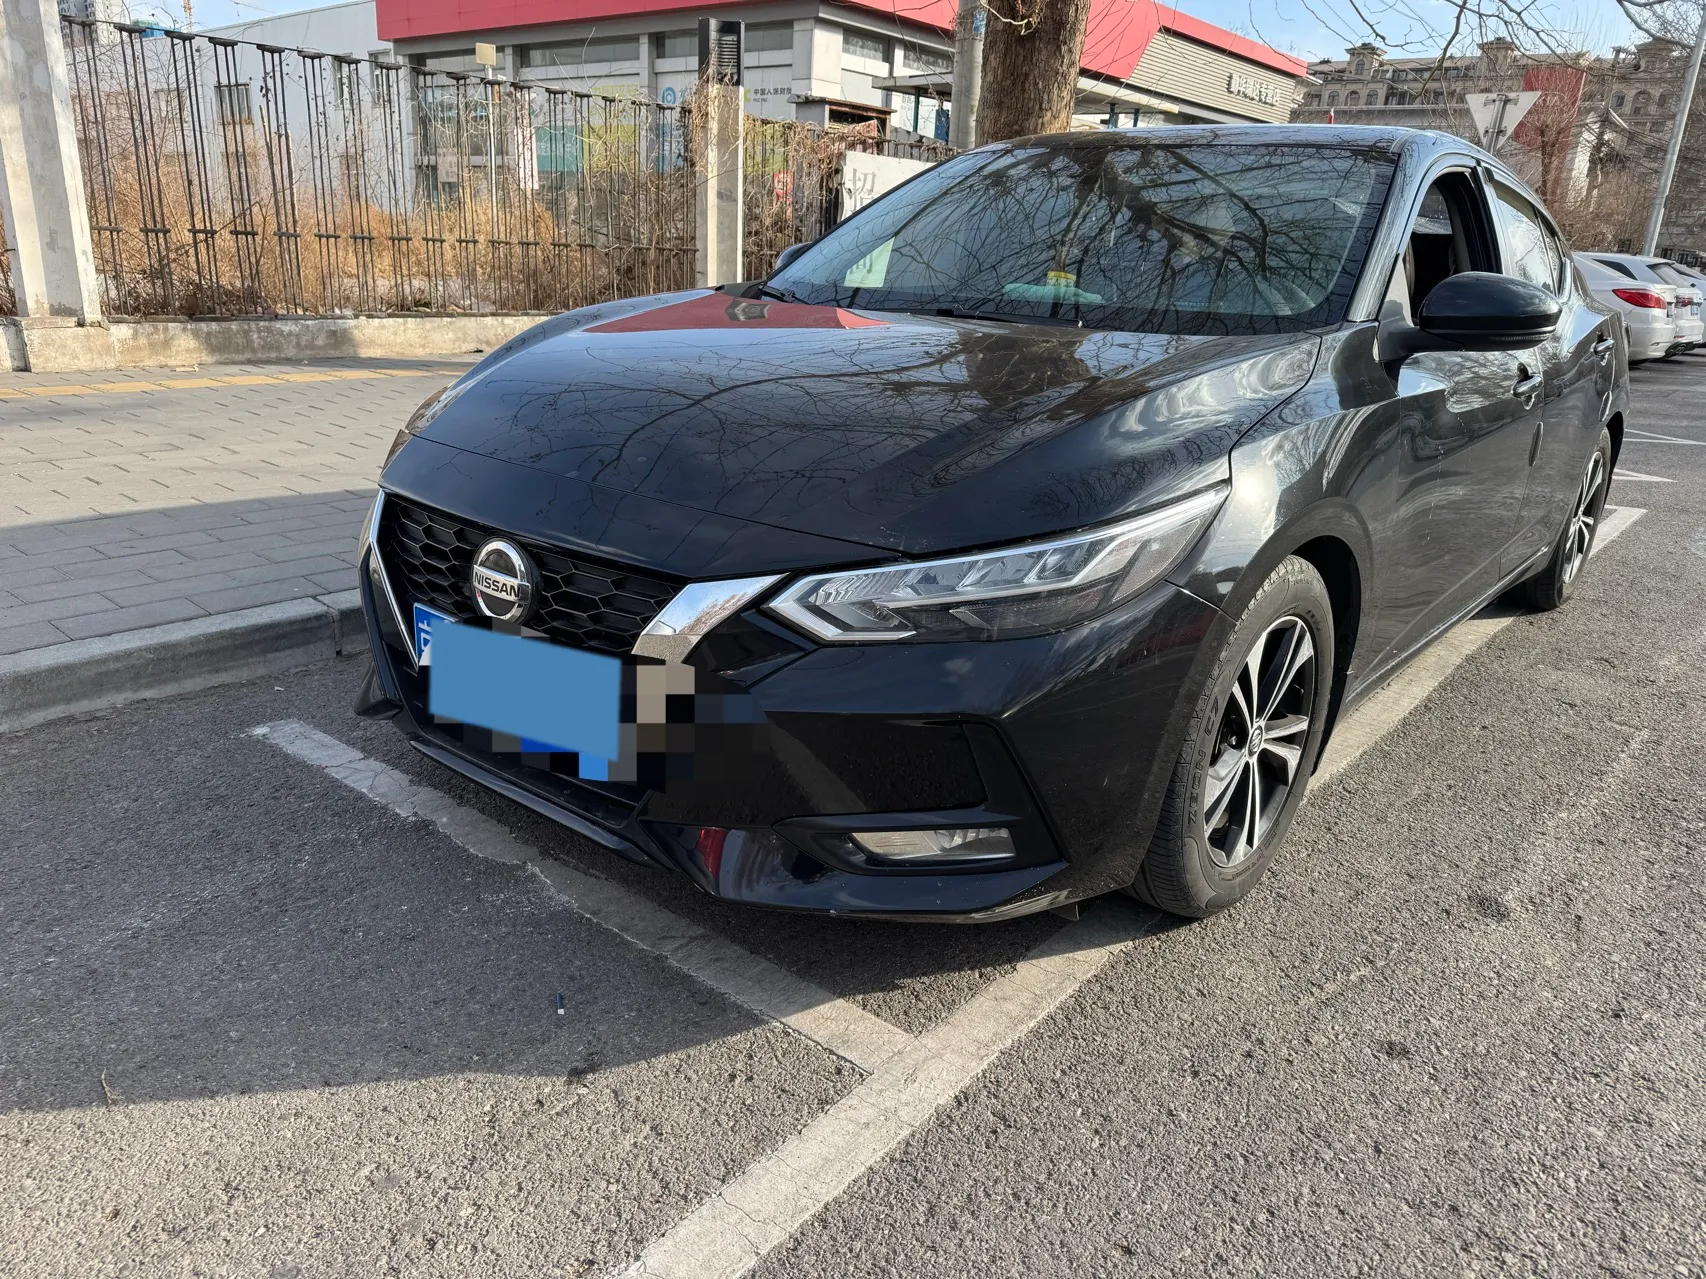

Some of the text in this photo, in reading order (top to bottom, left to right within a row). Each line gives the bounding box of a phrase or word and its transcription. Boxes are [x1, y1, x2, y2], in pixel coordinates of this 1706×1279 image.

[474, 571, 521, 598] NISSAN
[1188, 695, 1219, 825] ZEON C7
